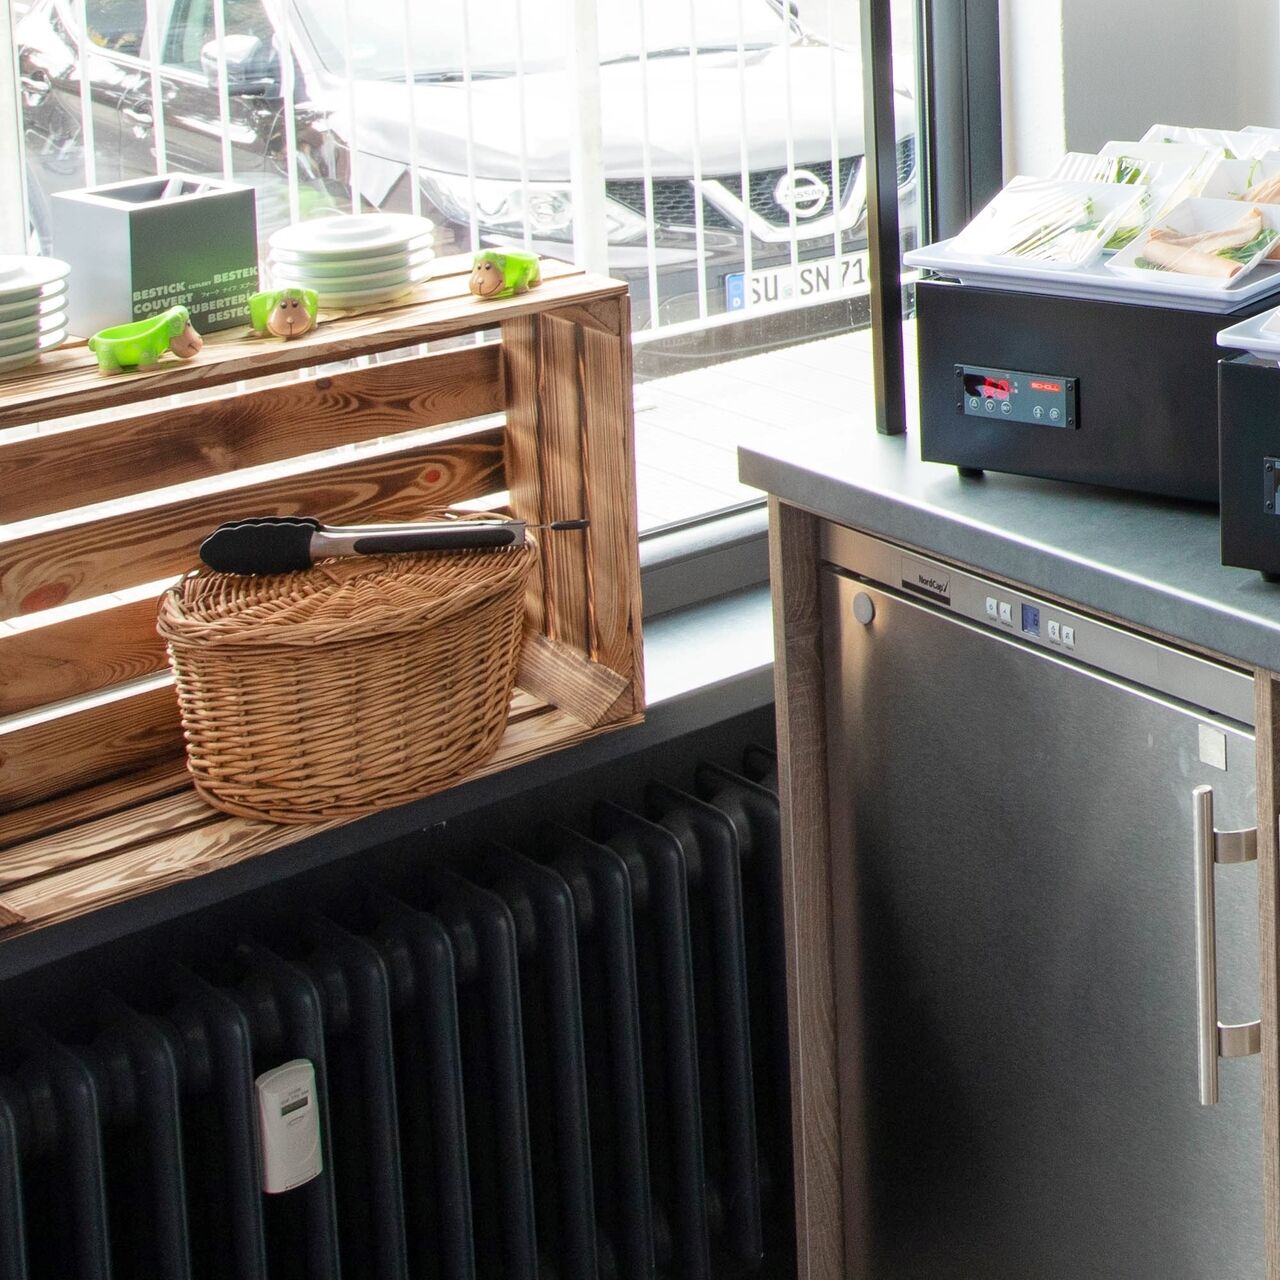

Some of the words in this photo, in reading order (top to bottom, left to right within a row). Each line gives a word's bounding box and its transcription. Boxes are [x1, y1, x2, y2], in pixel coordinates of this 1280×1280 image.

[133, 281, 186, 302] BESTICK
[214, 265, 258, 284] BESTEK
[800, 265, 830, 295] SN
[134, 293, 193, 314] COUVERT
[207, 305, 251, 323] BESTEC
[918, 574, 944, 594] NordCap
